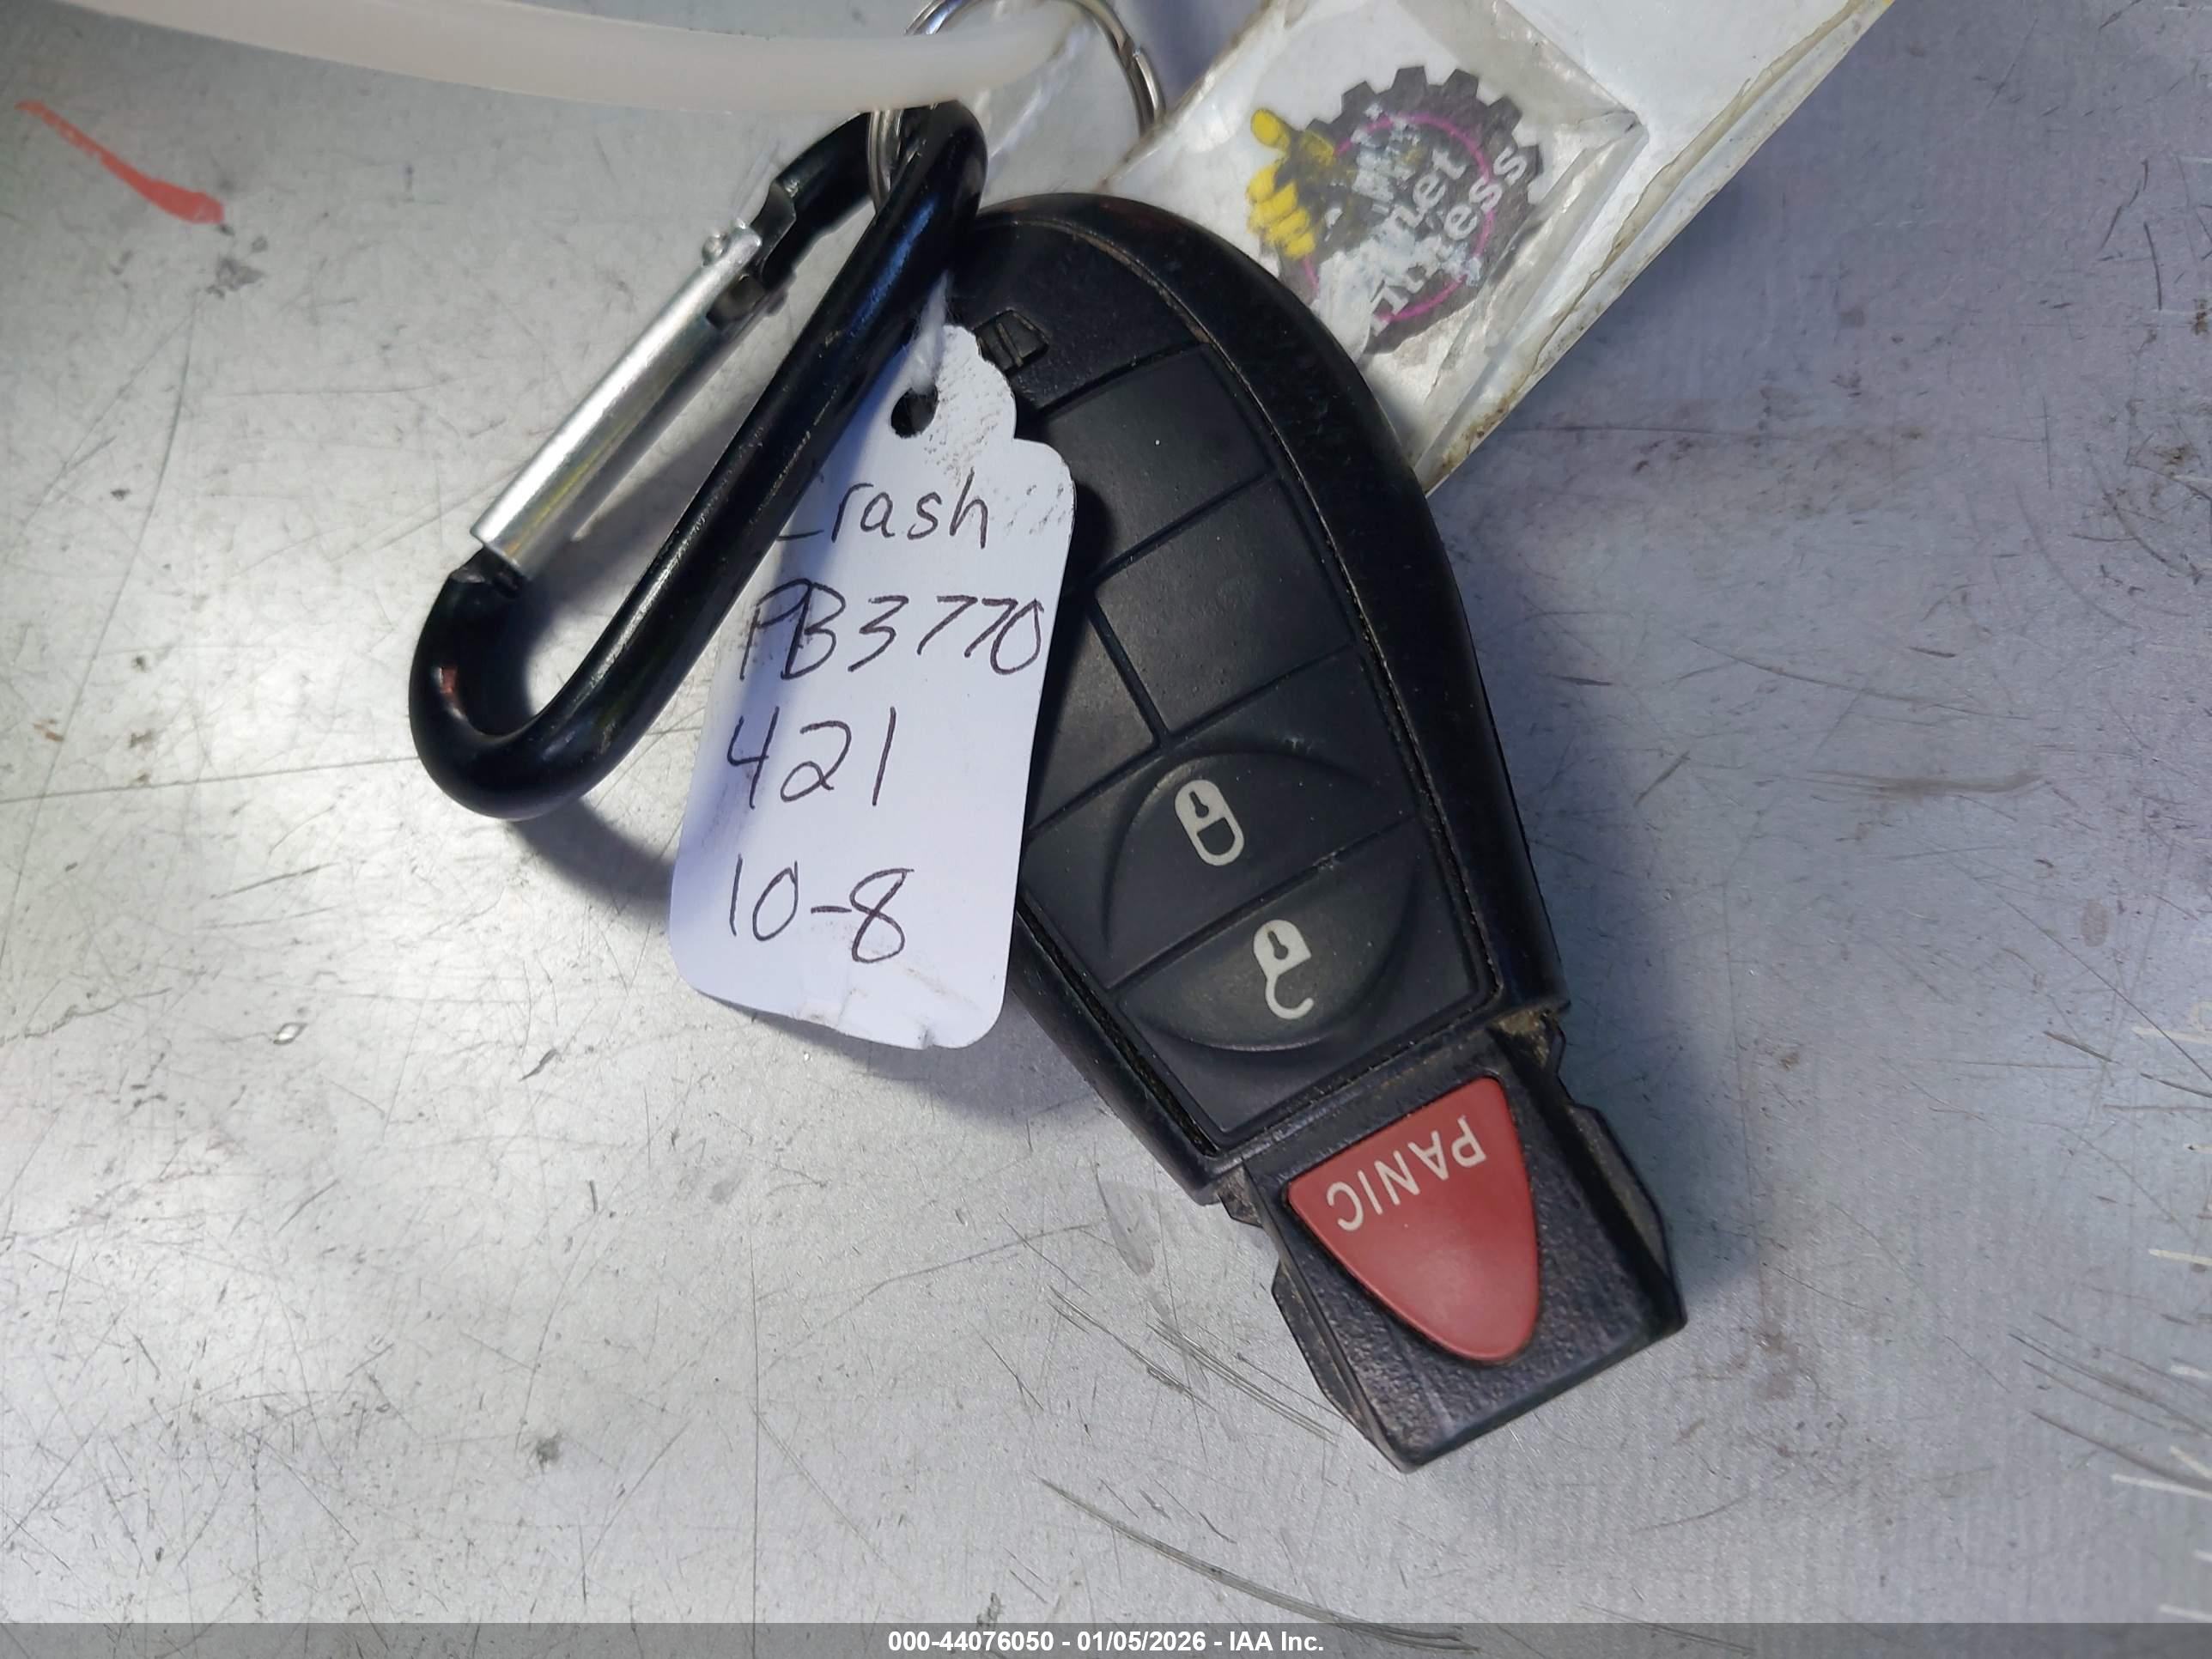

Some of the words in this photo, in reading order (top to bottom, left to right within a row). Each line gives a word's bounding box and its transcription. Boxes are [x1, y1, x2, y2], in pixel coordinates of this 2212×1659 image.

[726, 705, 896, 810] 421
[729, 852, 915, 963] 10-8
[1326, 1115, 1487, 1232] PANIC
